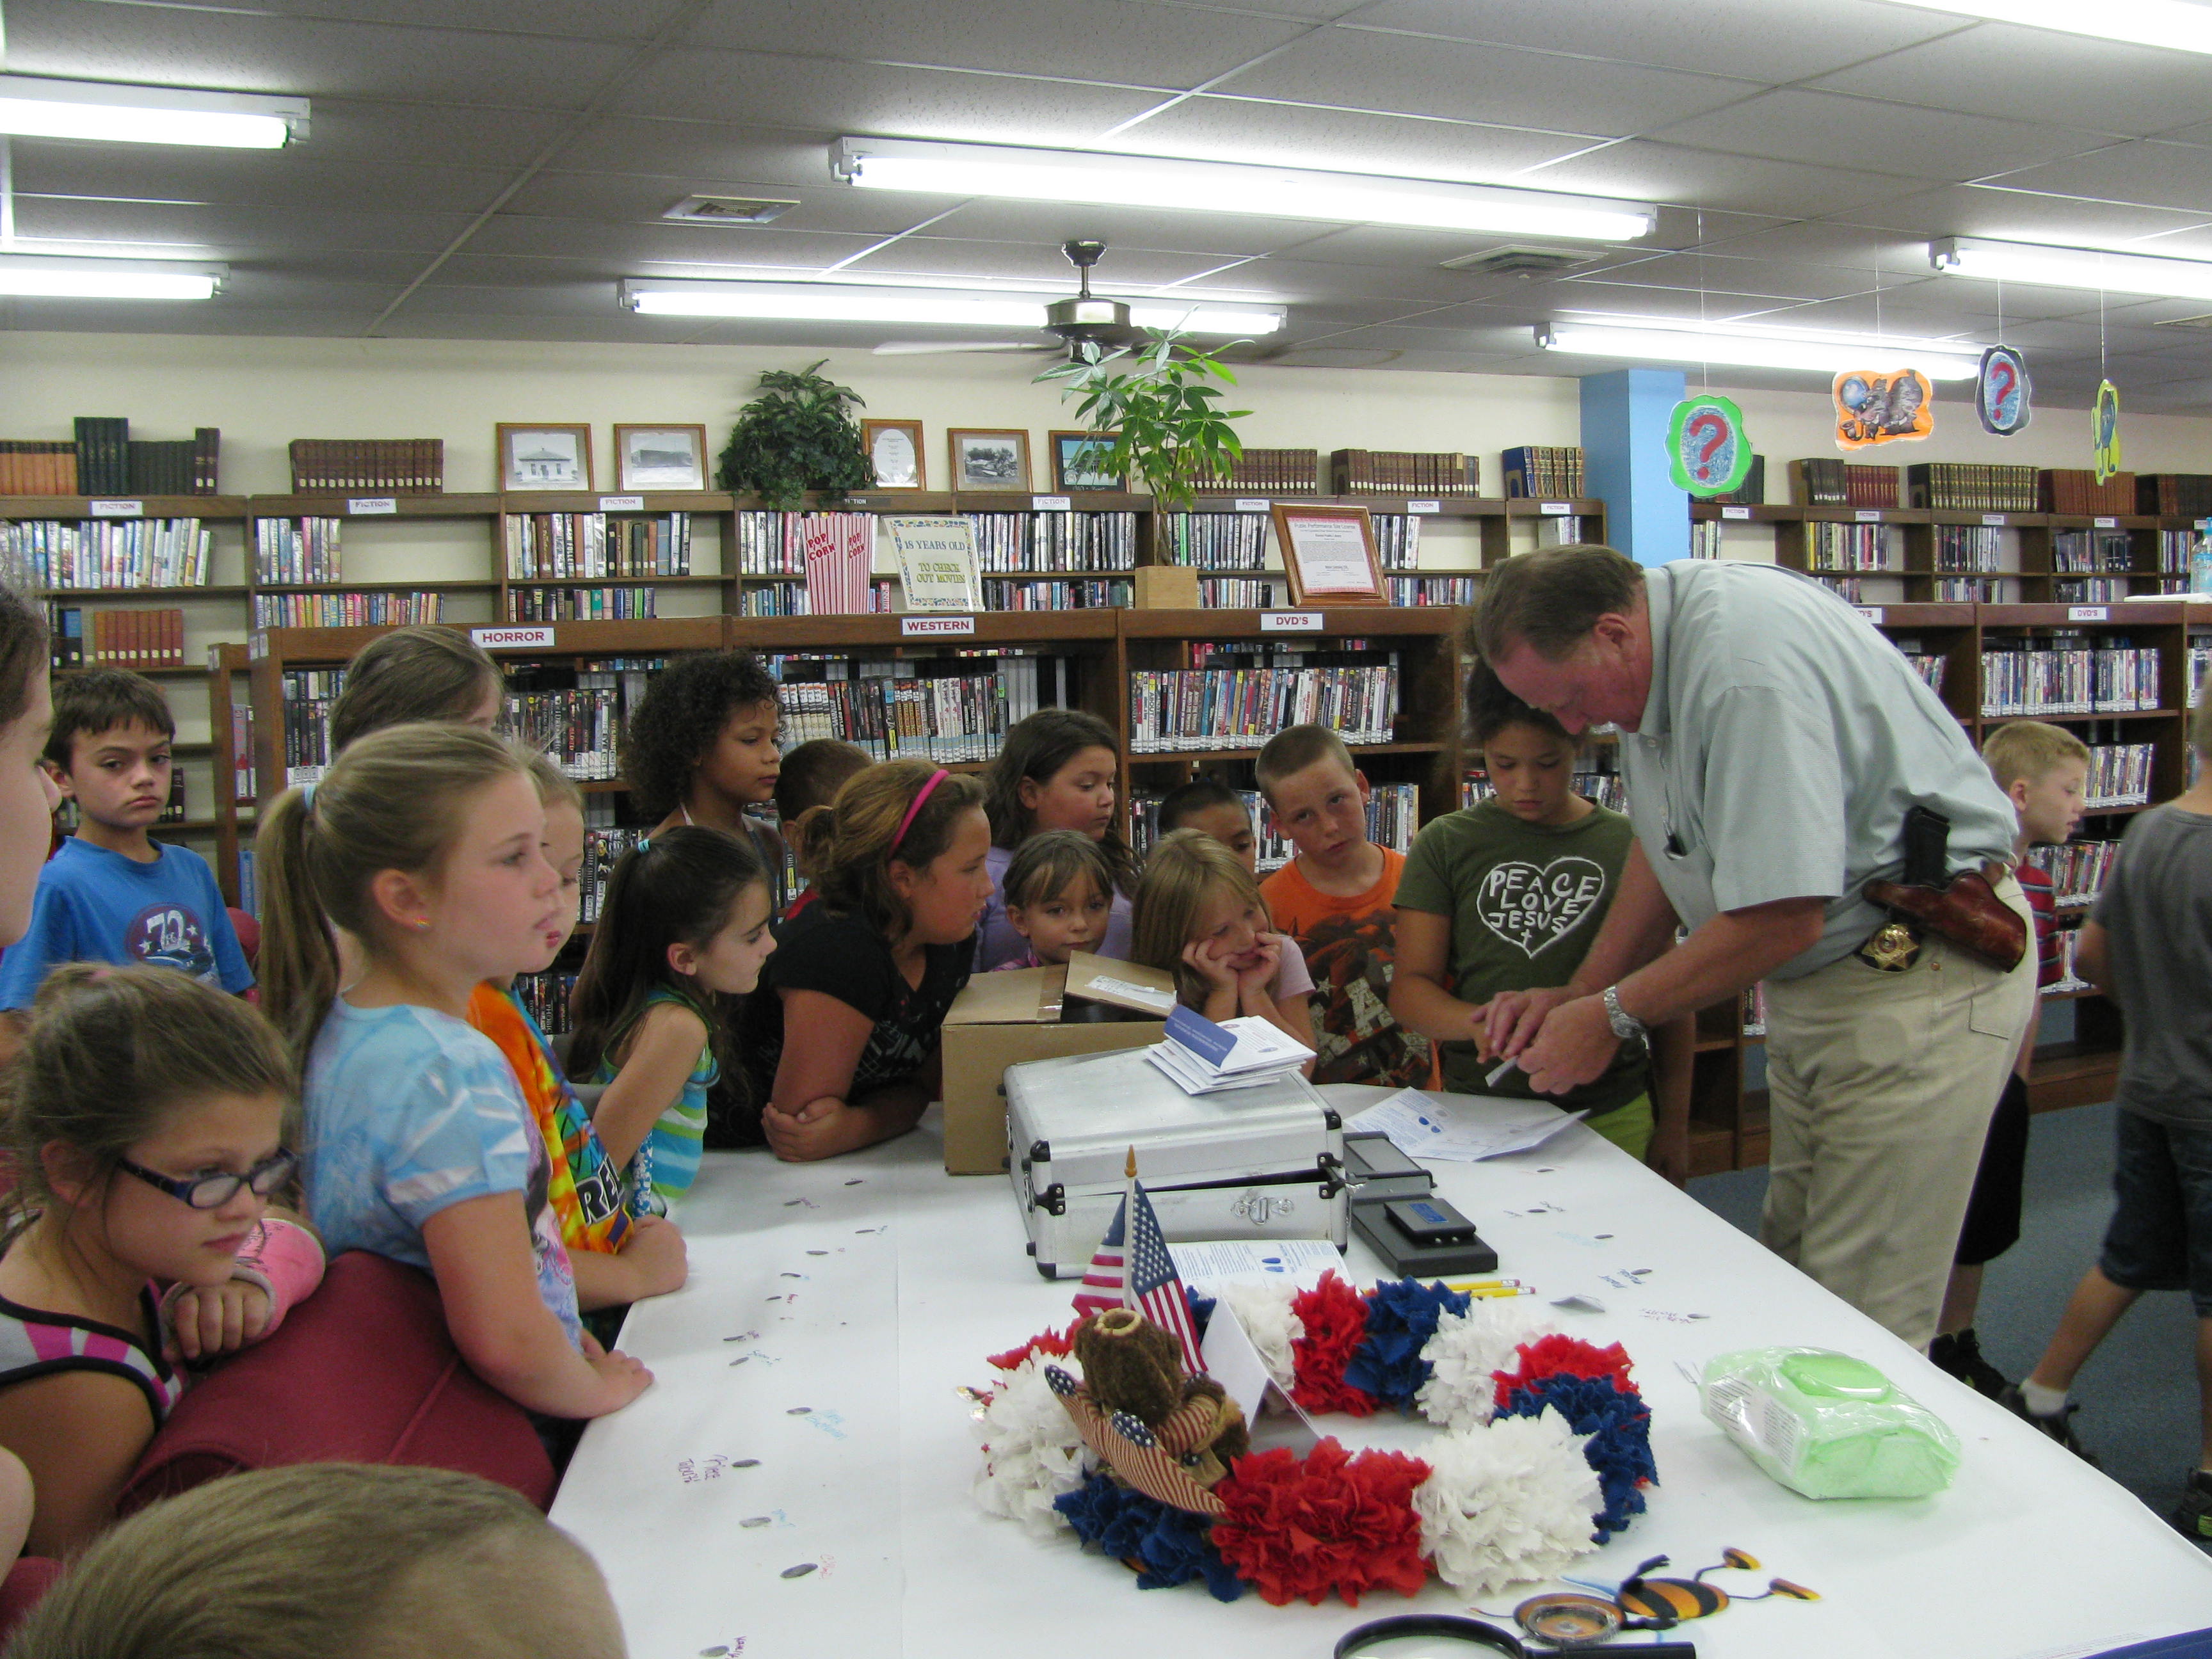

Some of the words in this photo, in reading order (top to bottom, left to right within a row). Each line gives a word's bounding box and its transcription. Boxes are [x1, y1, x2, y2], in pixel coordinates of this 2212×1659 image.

[806, 533, 827, 549] POP
[848, 532, 862, 546] POP
[904, 540, 913, 550] 18
[916, 541, 947, 550] YEARS
[949, 541, 965, 551] OLD
[808, 543, 835, 561] CORN
[848, 545, 865, 559] CORN
[918, 563, 930, 572] TO
[933, 563, 960, 573] CHECK
[916, 573, 934, 583] OUT
[937, 574, 966, 584] MOVIES
[1276, 615, 1309, 625] DVD'S
[2078, 609, 2098, 618] DVD'S
[907, 621, 970, 631] WESTERN
[482, 630, 545, 644] HORROR
[1489, 868, 1600, 901] PEACE
[1500, 888, 1581, 915] LOVE
[1488, 910, 1568, 936] JESUS
